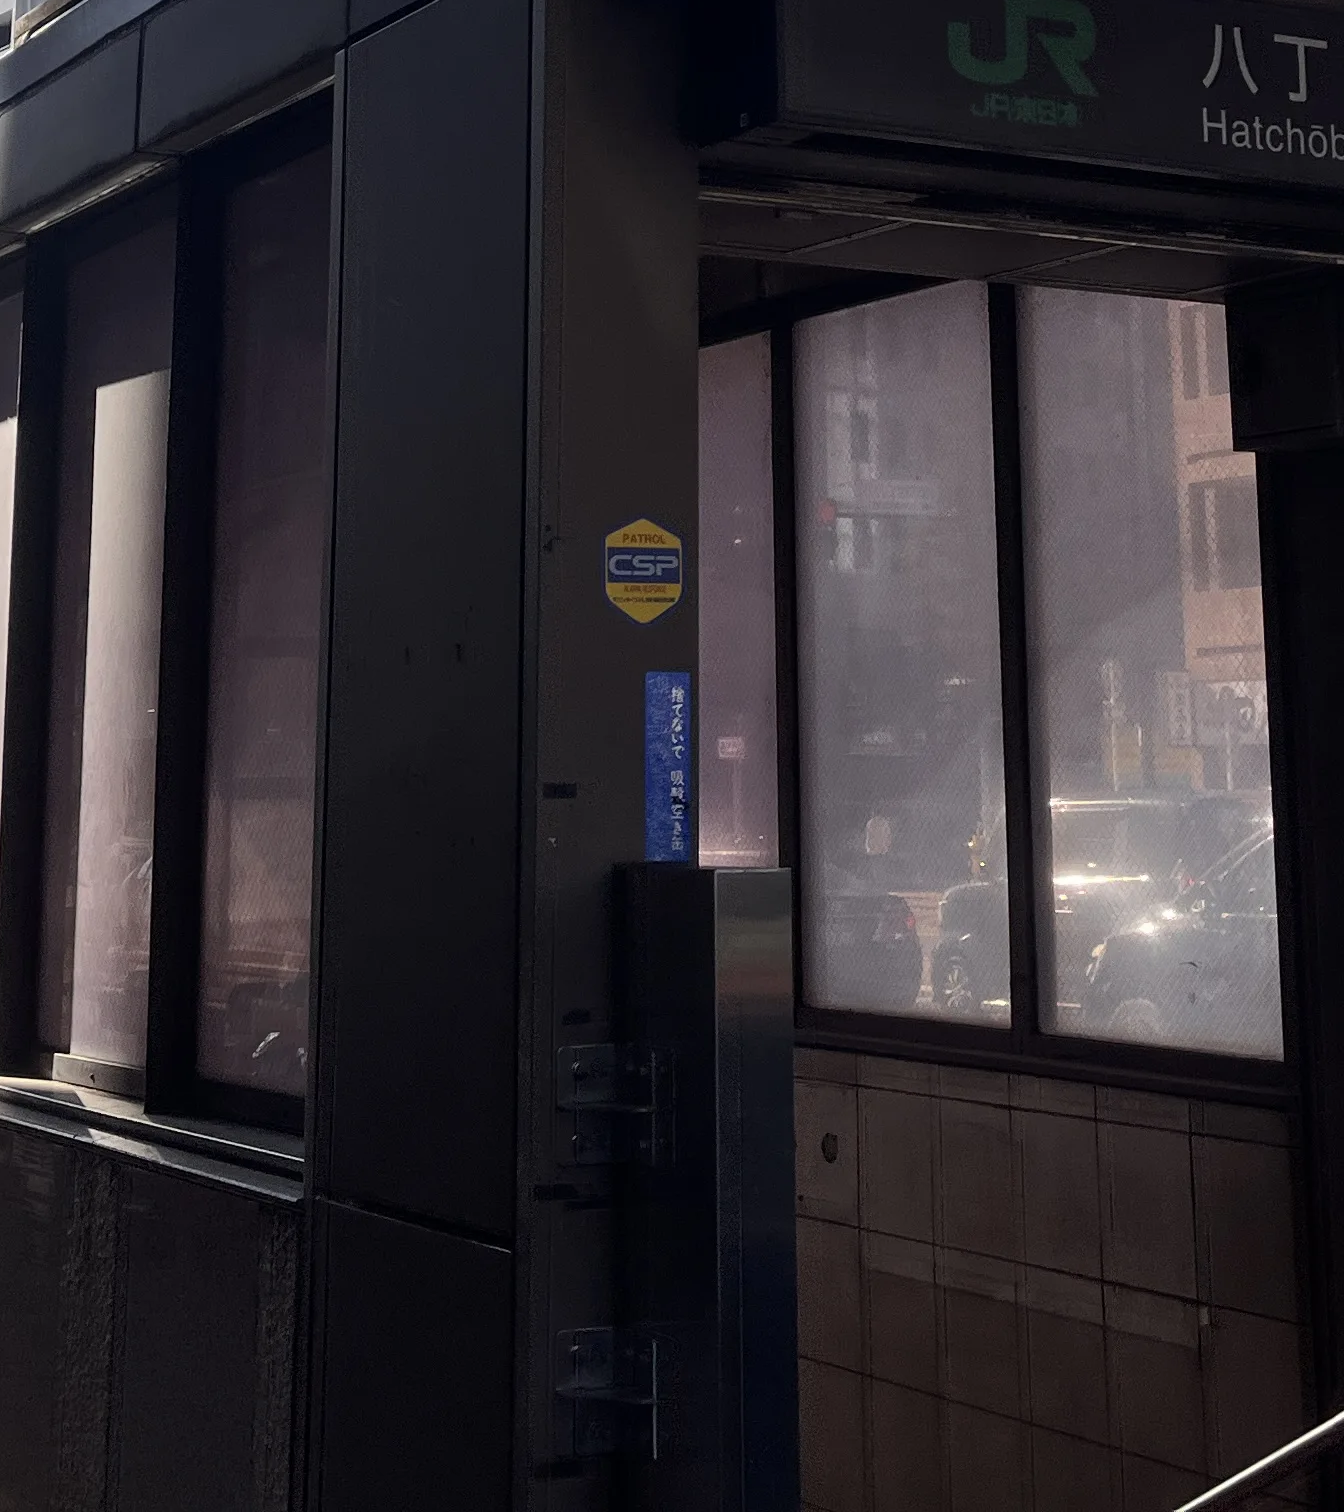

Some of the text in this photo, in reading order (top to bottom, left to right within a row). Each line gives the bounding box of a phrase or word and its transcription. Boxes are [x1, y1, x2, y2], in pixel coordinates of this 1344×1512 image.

[622, 533, 666, 544] PATROL
[608, 554, 680, 577] CSP
[670, 686, 685, 760] 捨てないで
